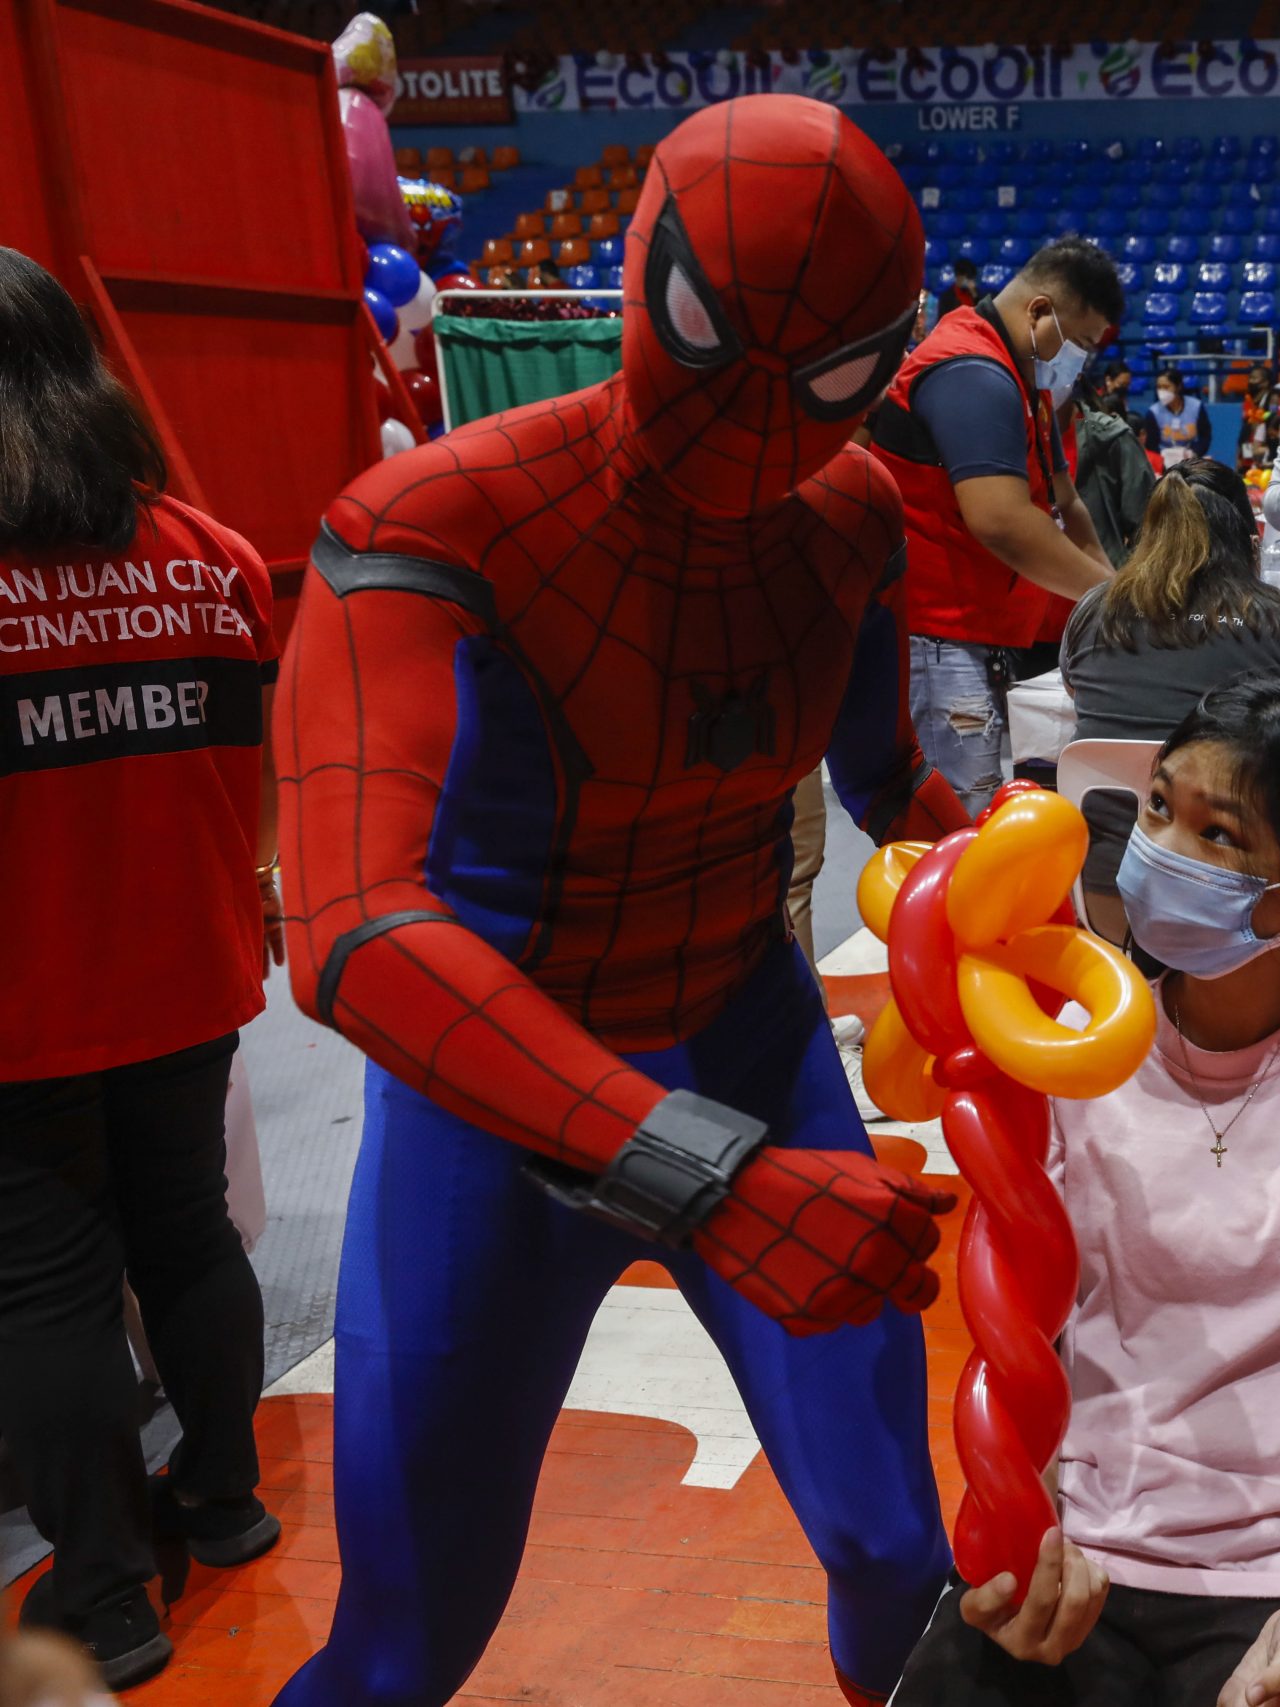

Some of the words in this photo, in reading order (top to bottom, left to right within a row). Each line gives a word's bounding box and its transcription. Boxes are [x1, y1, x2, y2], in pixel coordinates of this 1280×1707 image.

[392, 69, 503, 98] TOLITE
[918, 107, 998, 130] LOWER
[1006, 106, 1019, 129] F
[56, 560, 158, 600] JUAN
[165, 559, 239, 597] CITY
[194, 602, 253, 638] TEA
[17, 680, 209, 746] MEMBER
